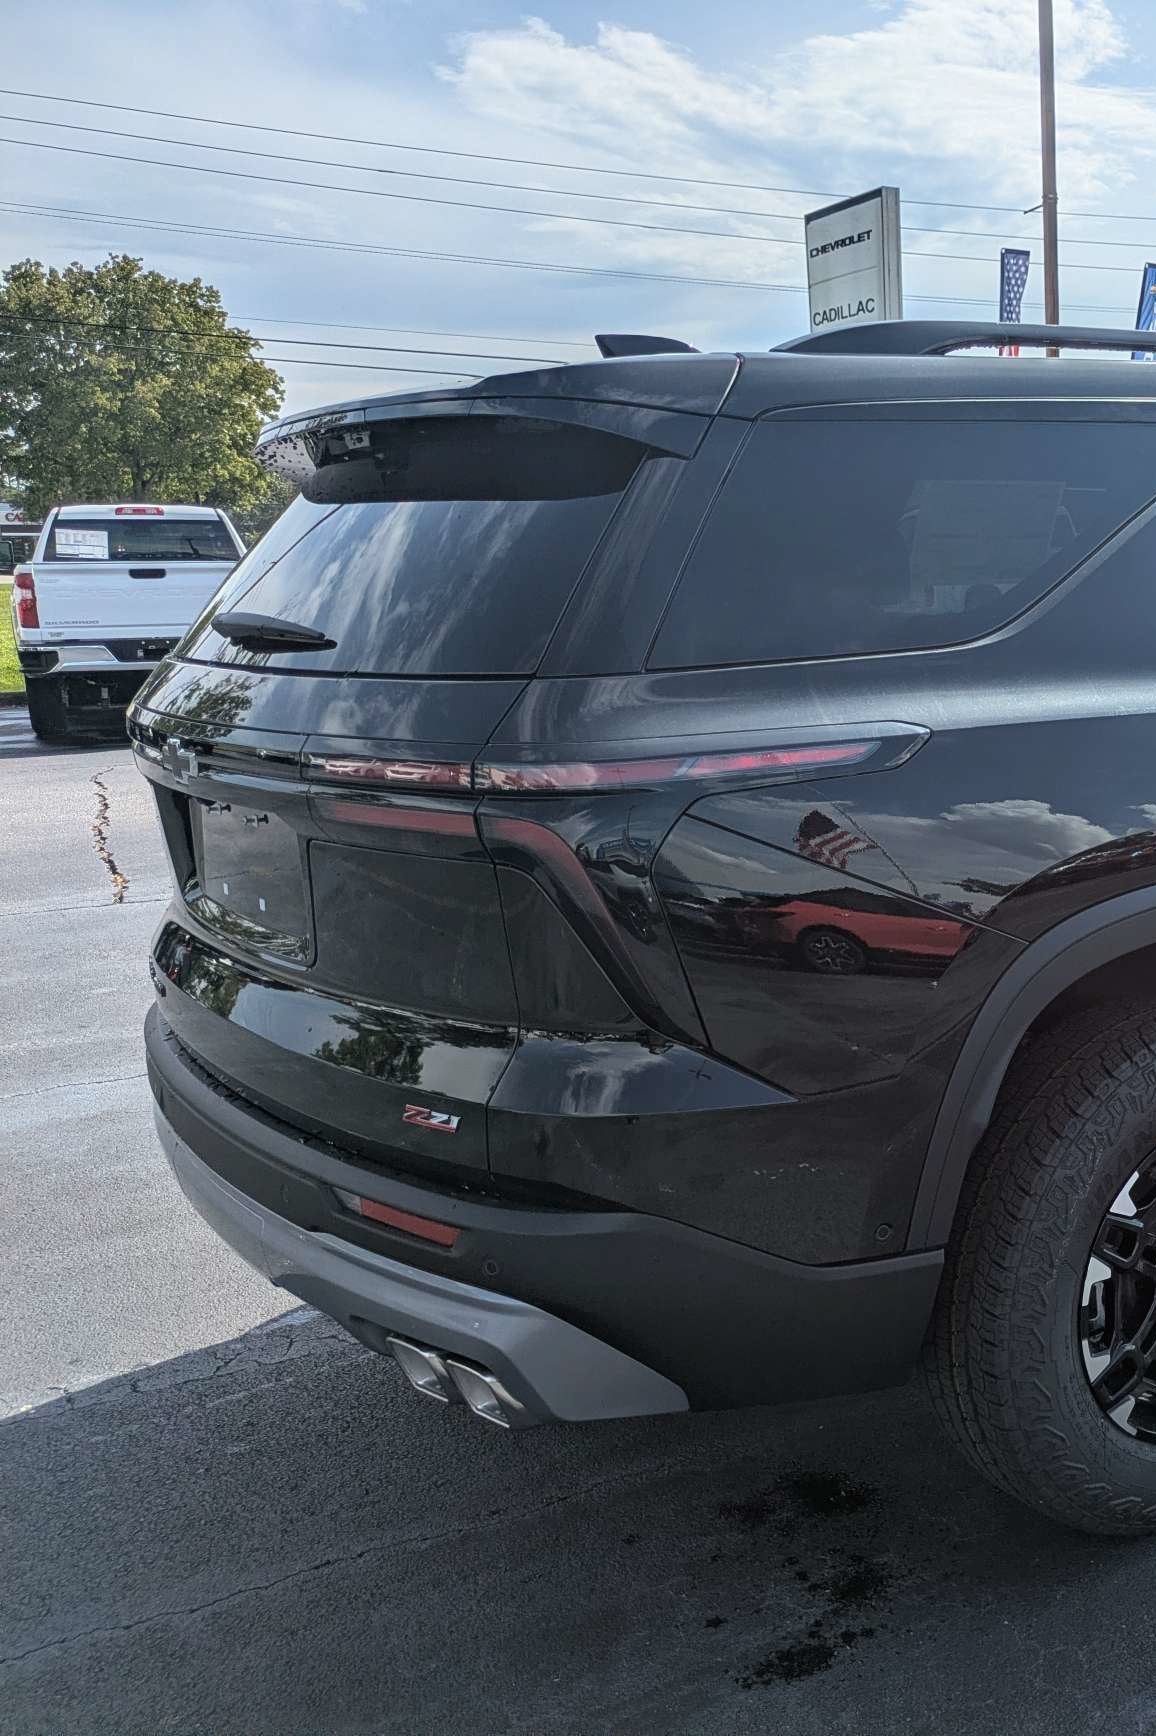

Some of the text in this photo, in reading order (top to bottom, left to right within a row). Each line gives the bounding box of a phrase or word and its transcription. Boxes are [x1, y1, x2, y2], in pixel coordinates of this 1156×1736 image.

[809, 229, 873, 259] CHEVROLET
[812, 297, 876, 327] CADILLAC
[402, 1103, 463, 1134] Z71
